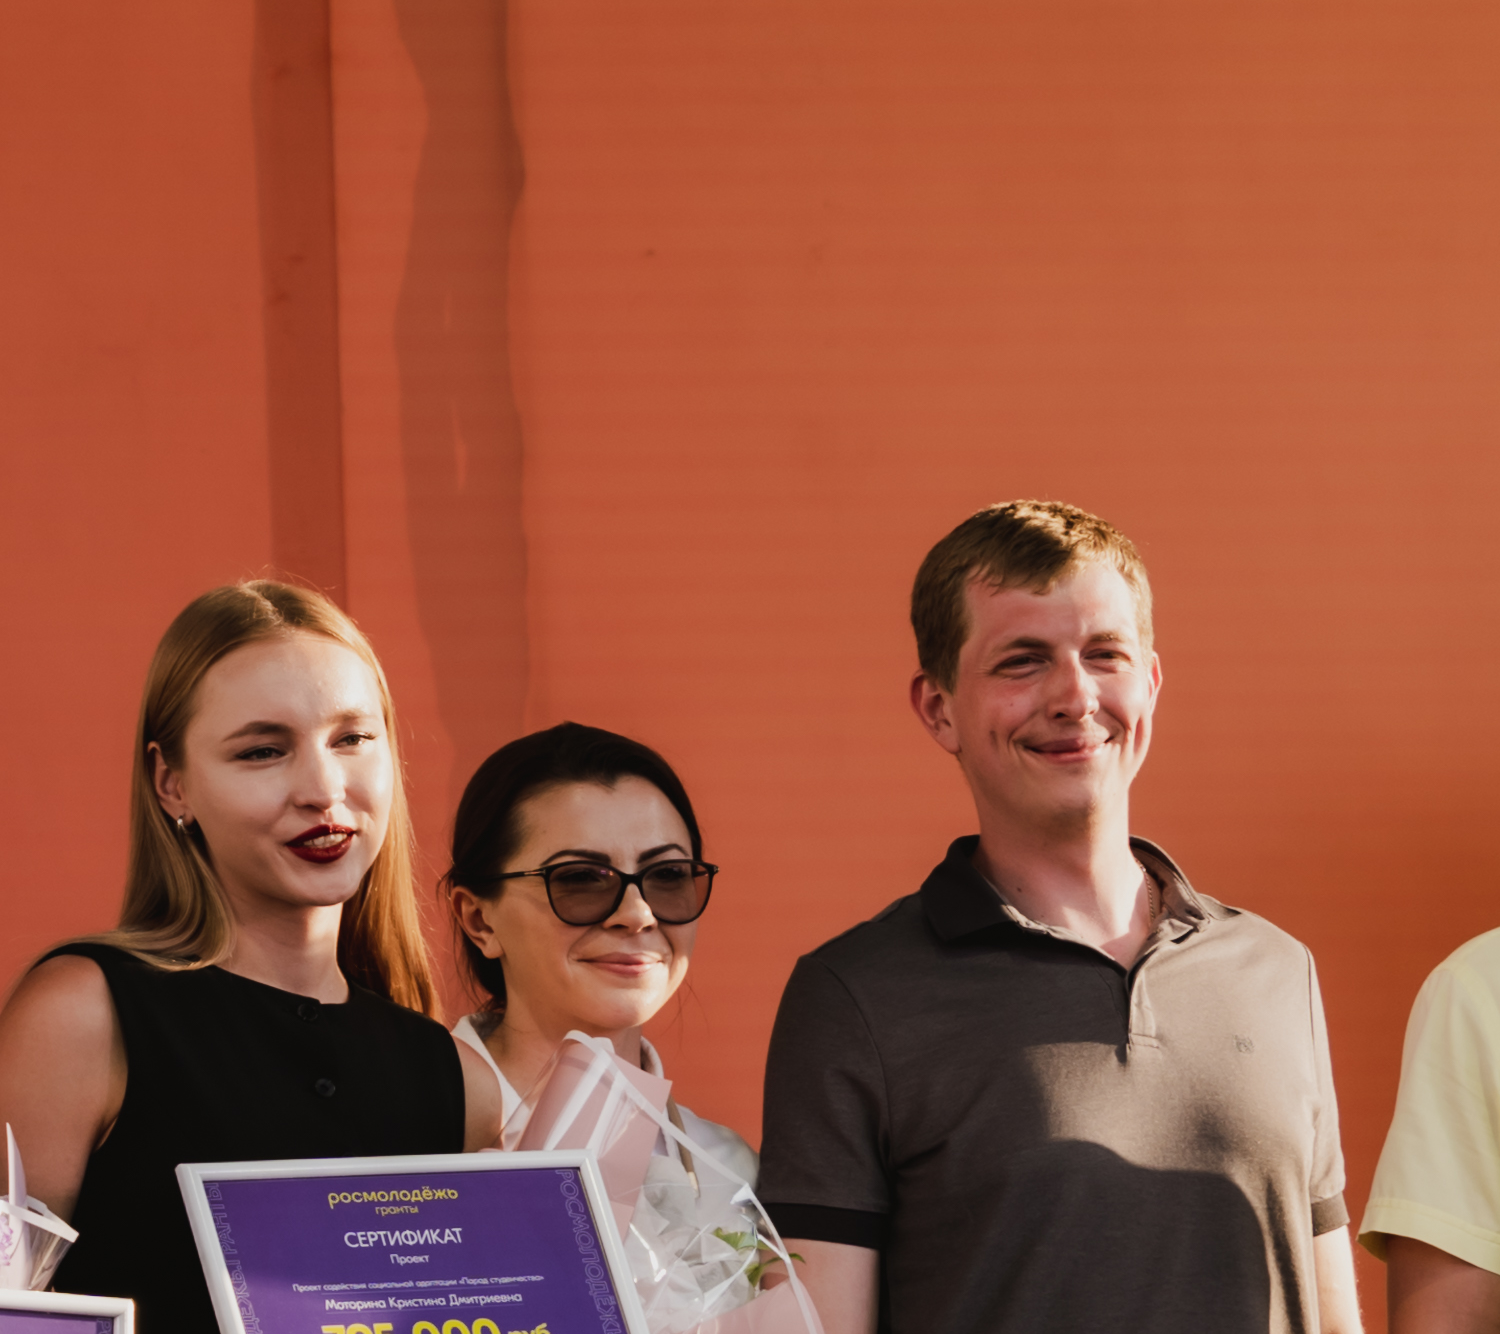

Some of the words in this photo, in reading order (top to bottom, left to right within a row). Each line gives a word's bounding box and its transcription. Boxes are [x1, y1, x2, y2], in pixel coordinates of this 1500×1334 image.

[327, 1185, 459, 1210] росмолодёжь
[374, 1205, 419, 1217] гранты
[343, 1227, 463, 1248] СЕРТИФИКАТ
[389, 1253, 430, 1266] Проект
[387, 1296, 447, 1310] Кристина
[448, 1293, 523, 1307] Дмитриевна
